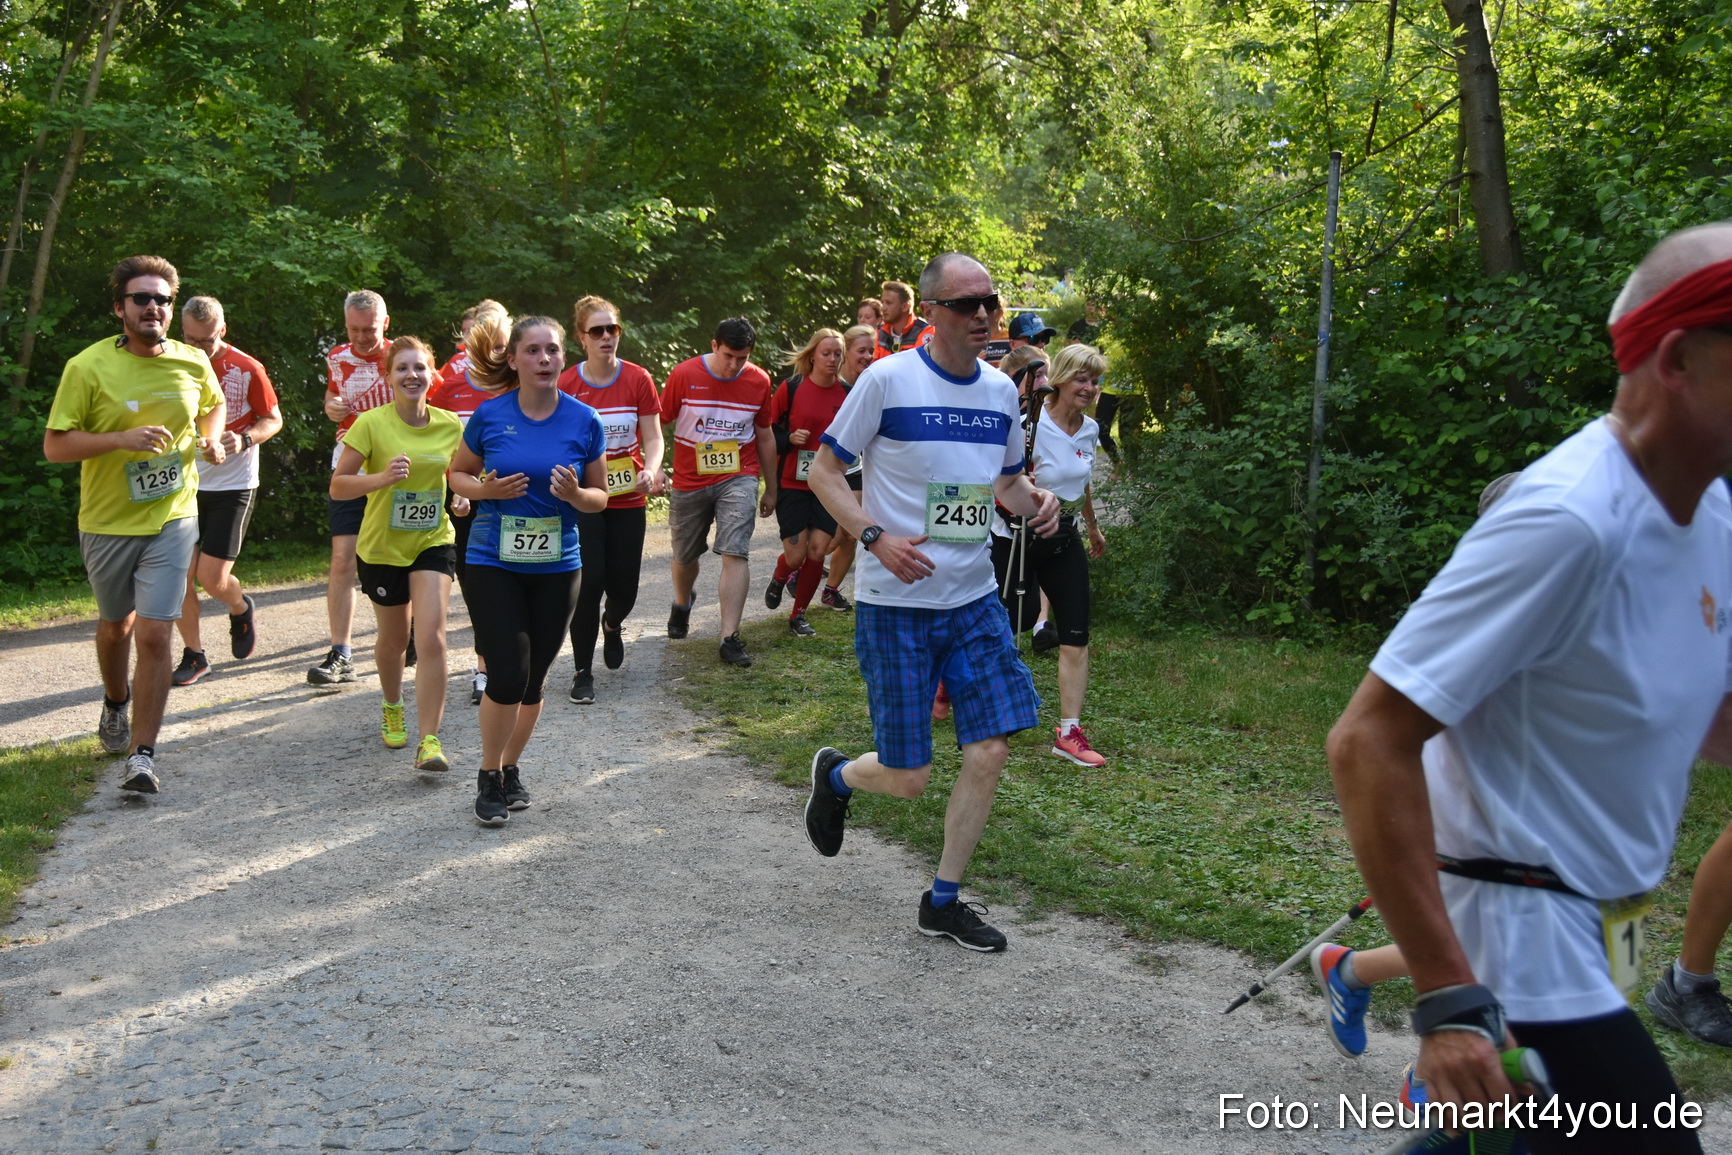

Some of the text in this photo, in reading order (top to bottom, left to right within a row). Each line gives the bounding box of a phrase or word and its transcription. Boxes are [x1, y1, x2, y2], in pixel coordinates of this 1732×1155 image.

[705, 417, 746, 432] Petry
[921, 412, 1000, 429] TR PLAST
[702, 452, 733, 466] 1831
[801, 460, 813, 472] 2
[136, 466, 178, 491] 1236
[398, 504, 437, 520] 1299
[934, 503, 988, 527] 2430
[513, 533, 549, 550] 572
